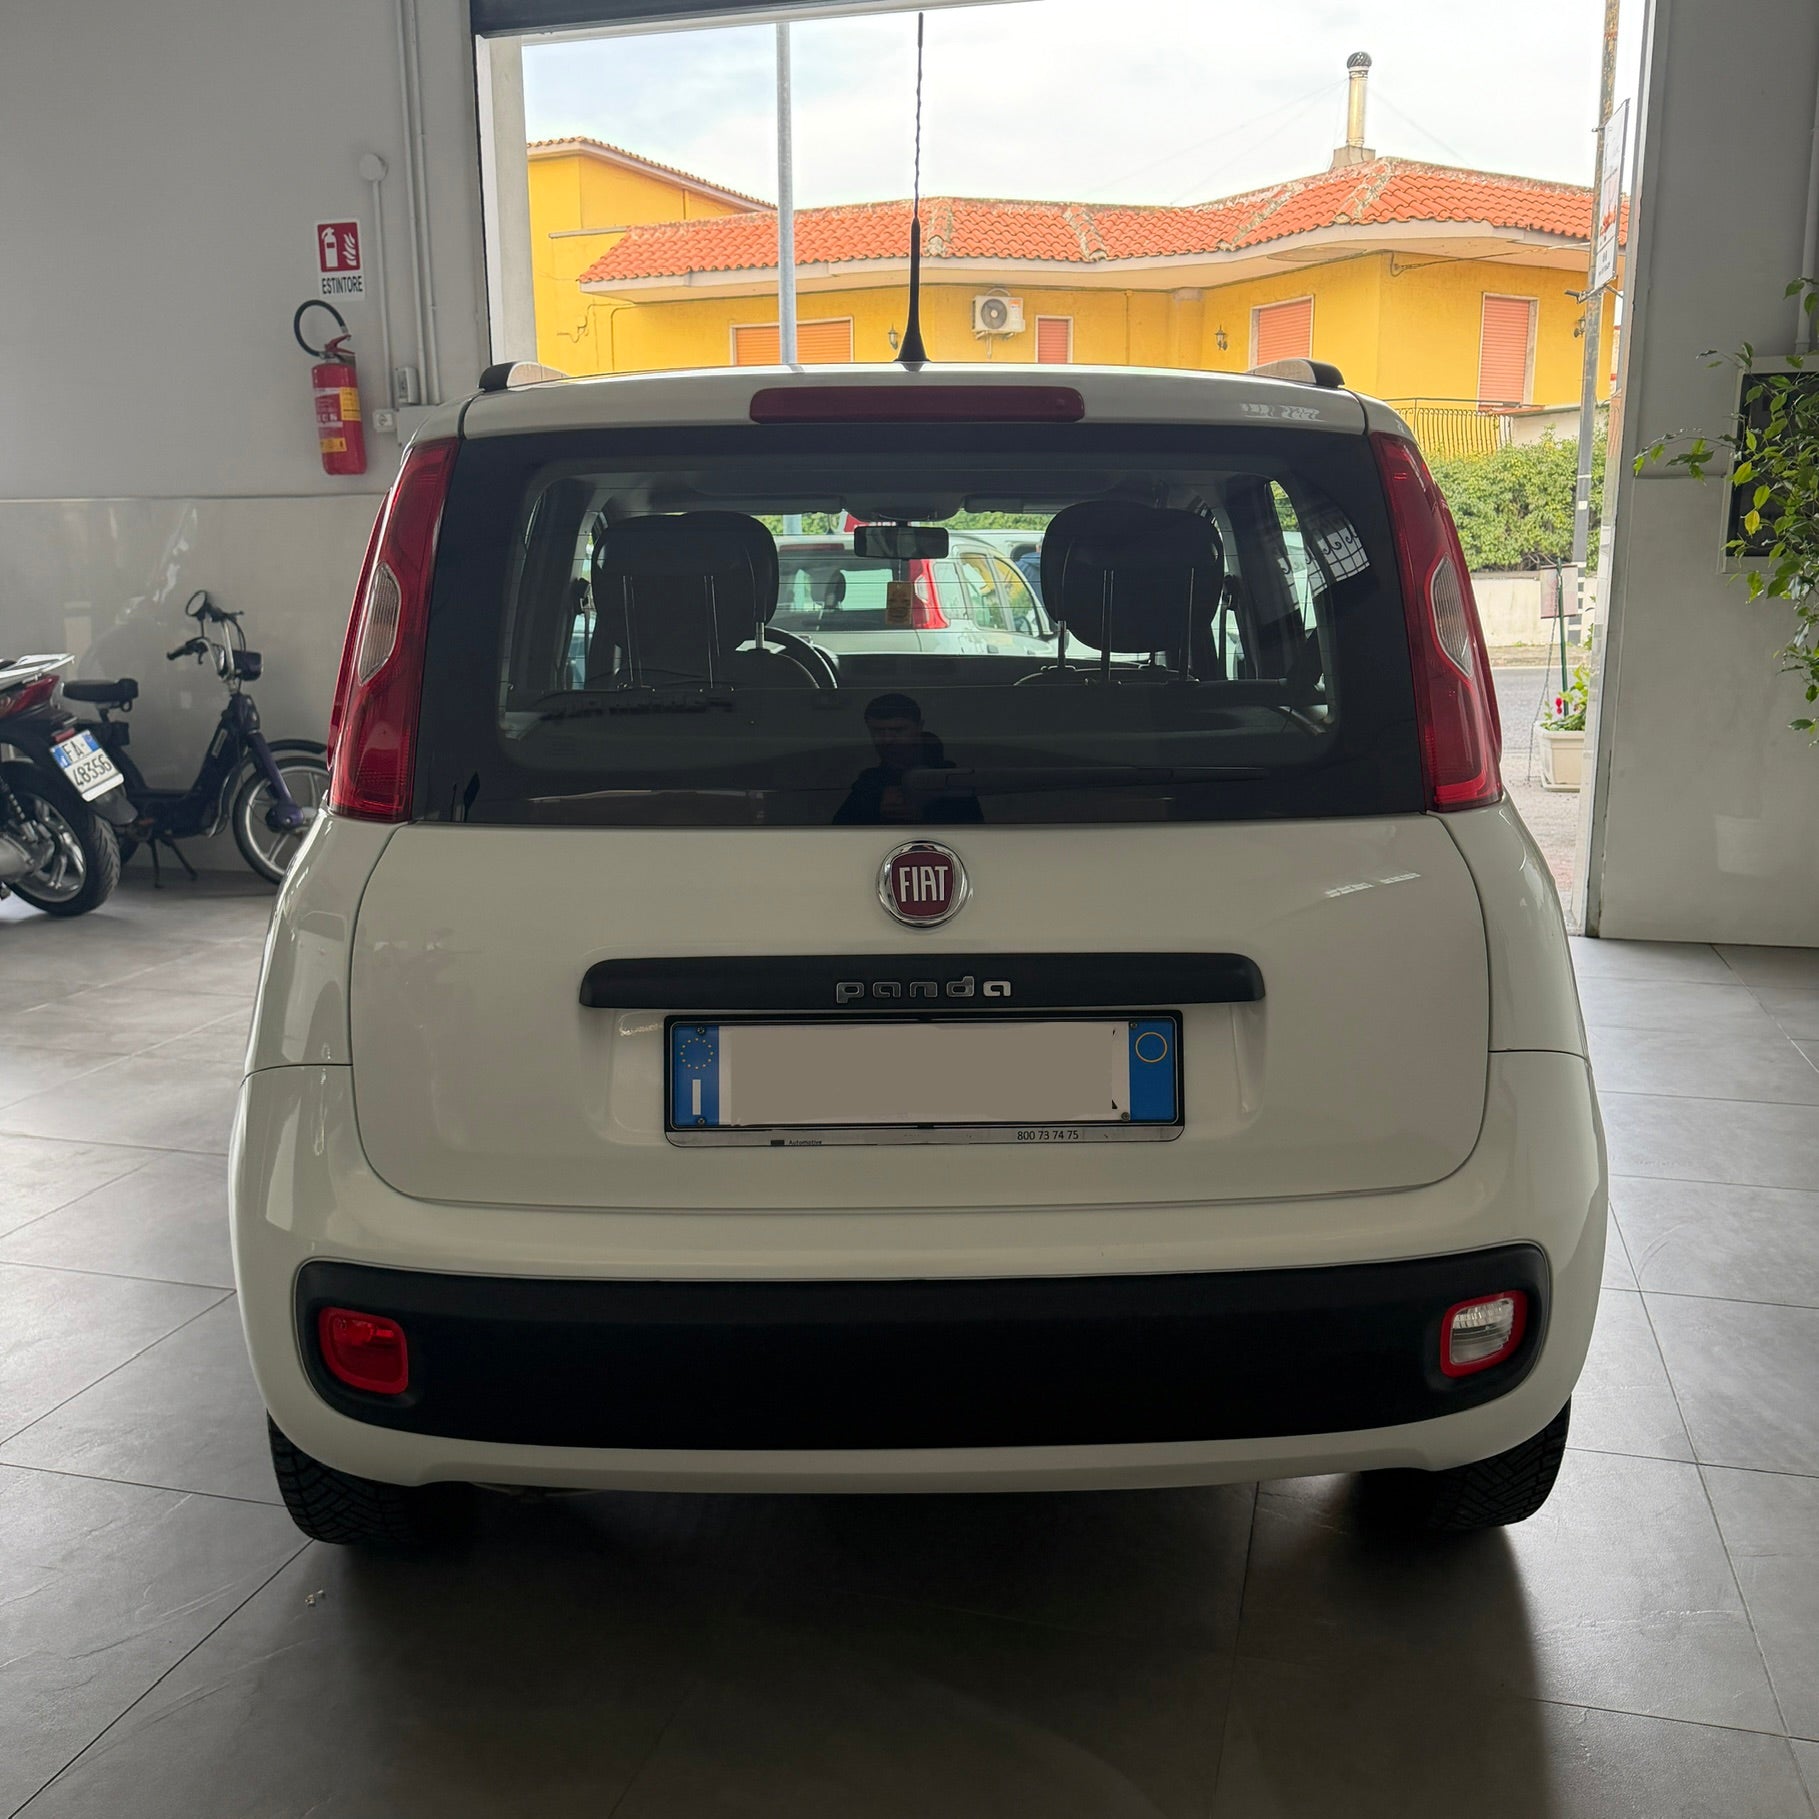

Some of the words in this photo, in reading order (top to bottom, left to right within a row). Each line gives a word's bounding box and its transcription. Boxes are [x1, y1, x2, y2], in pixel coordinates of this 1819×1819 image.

[321, 276, 363, 294] ESTINTORE
[899, 866, 949, 902] FIAT
[836, 976, 1012, 1003] panda
[1017, 1130, 1035, 1141] 800
[1038, 1130, 1050, 1141] 73
[1052, 1130, 1065, 1140] 74
[1067, 1130, 1079, 1140] 75
